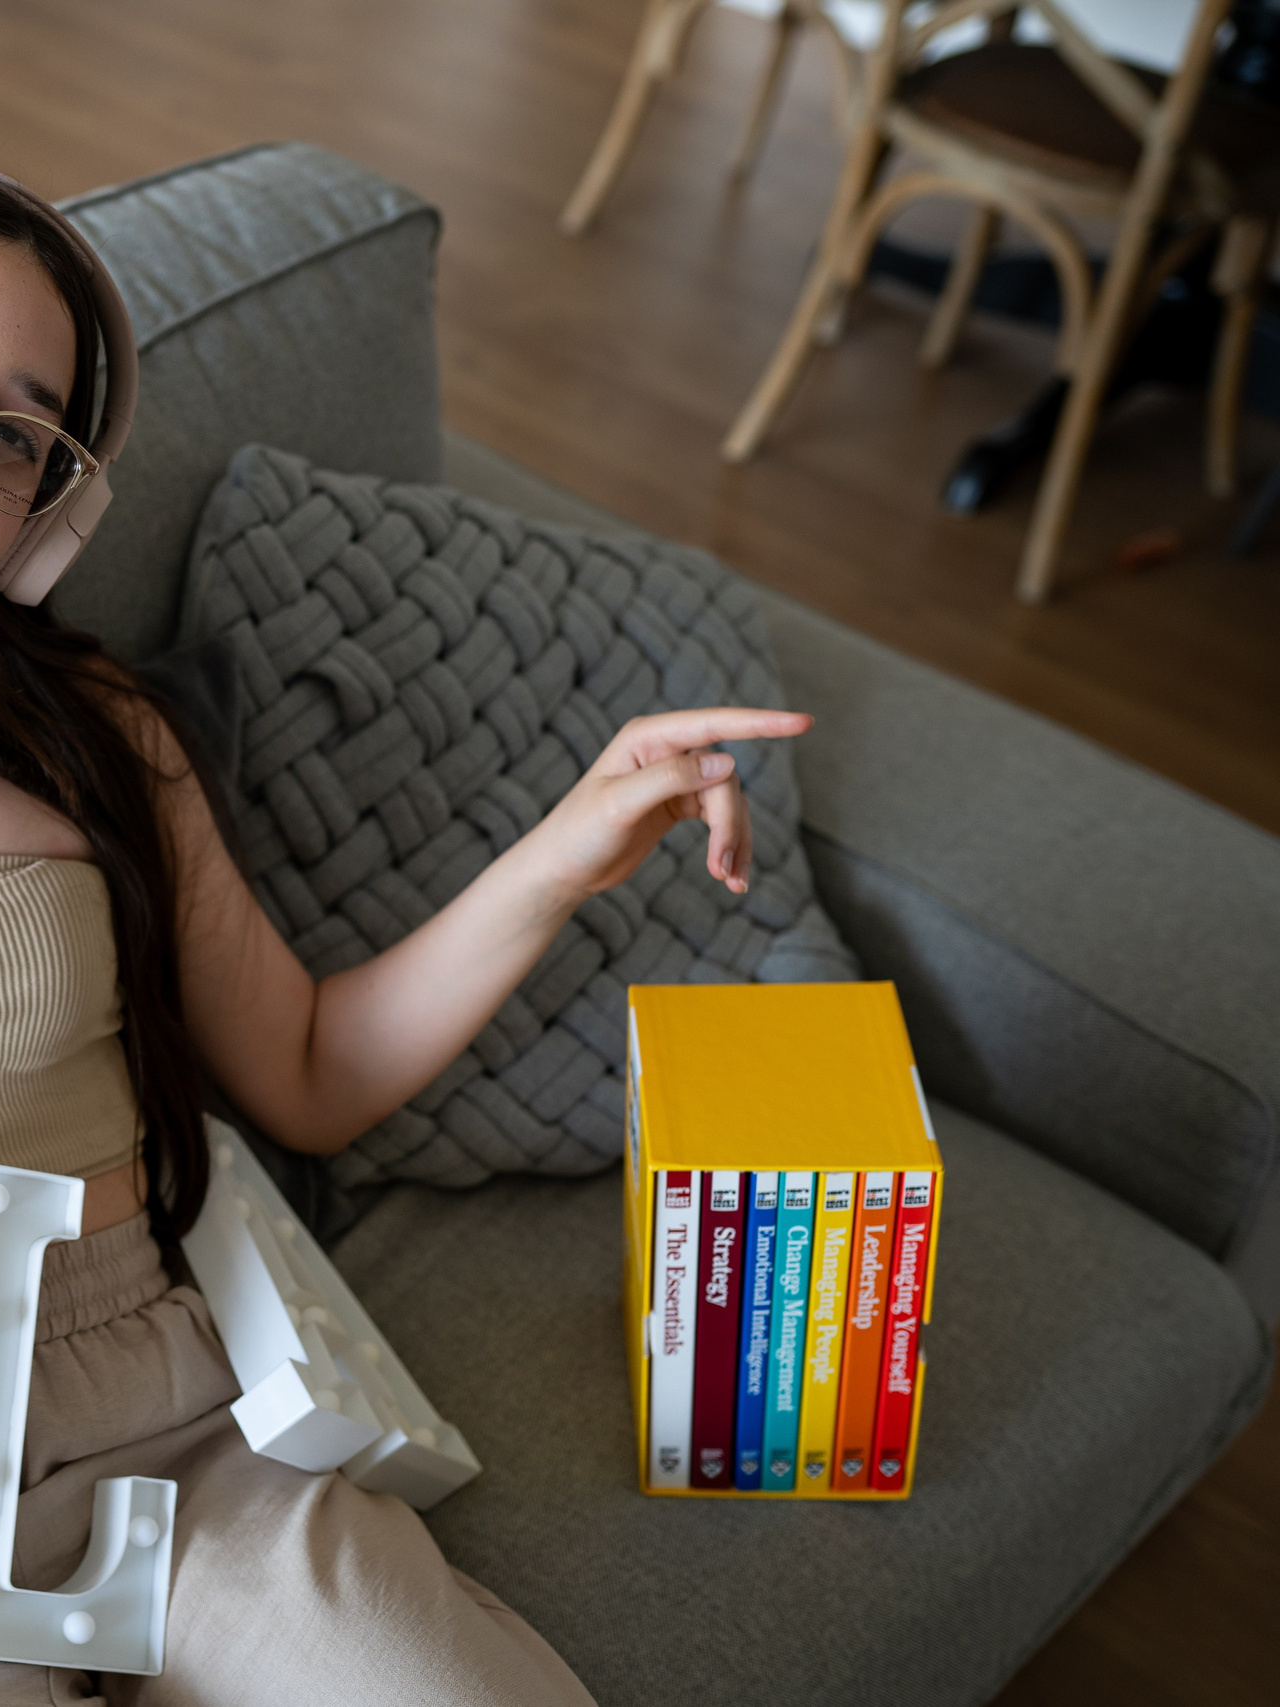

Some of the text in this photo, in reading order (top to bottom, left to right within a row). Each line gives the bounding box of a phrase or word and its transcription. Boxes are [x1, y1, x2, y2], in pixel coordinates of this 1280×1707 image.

[667, 1224, 687, 1260] The
[705, 1227, 736, 1307] Strategy
[754, 1225, 775, 1306] Emotional
[780, 1226, 809, 1295] Change
[813, 1227, 846, 1321] Managing
[851, 1224, 886, 1330] Leadership
[891, 1223, 925, 1315] Managing
[664, 1267, 686, 1356] Essentials
[747, 1309, 770, 1395] Intelligence
[776, 1299, 803, 1412] Management
[812, 1324, 838, 1384] People
[887, 1317, 916, 1395] Yourself
